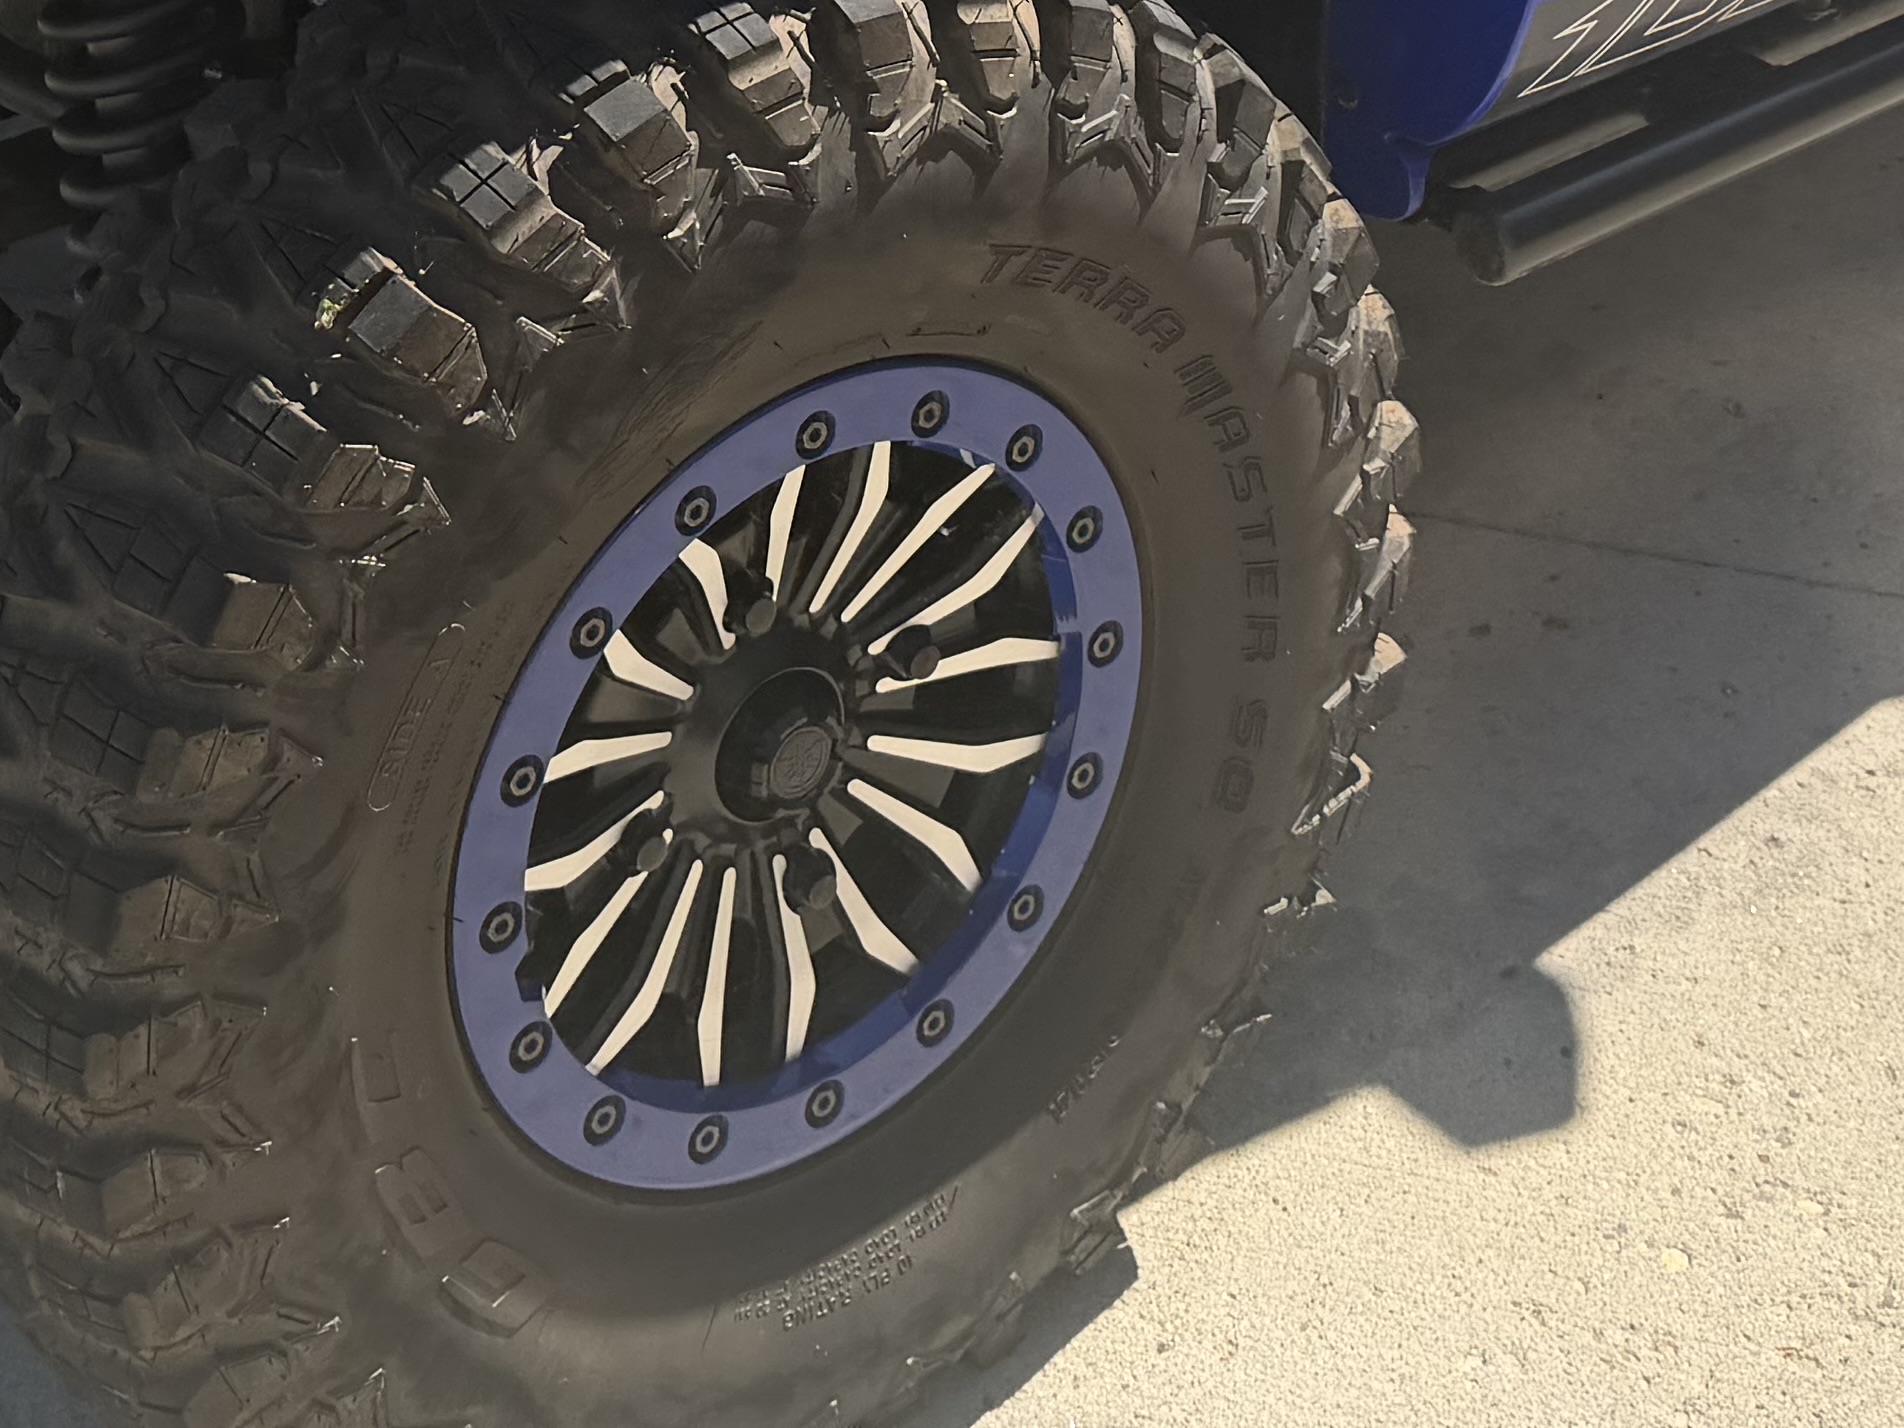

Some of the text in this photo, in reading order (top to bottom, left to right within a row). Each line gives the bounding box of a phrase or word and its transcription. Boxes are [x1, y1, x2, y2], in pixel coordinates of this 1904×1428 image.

[981, 243, 1186, 352] TERRA
[1176, 355, 1279, 663] MASTER
[782, 1288, 852, 1331] RATING
